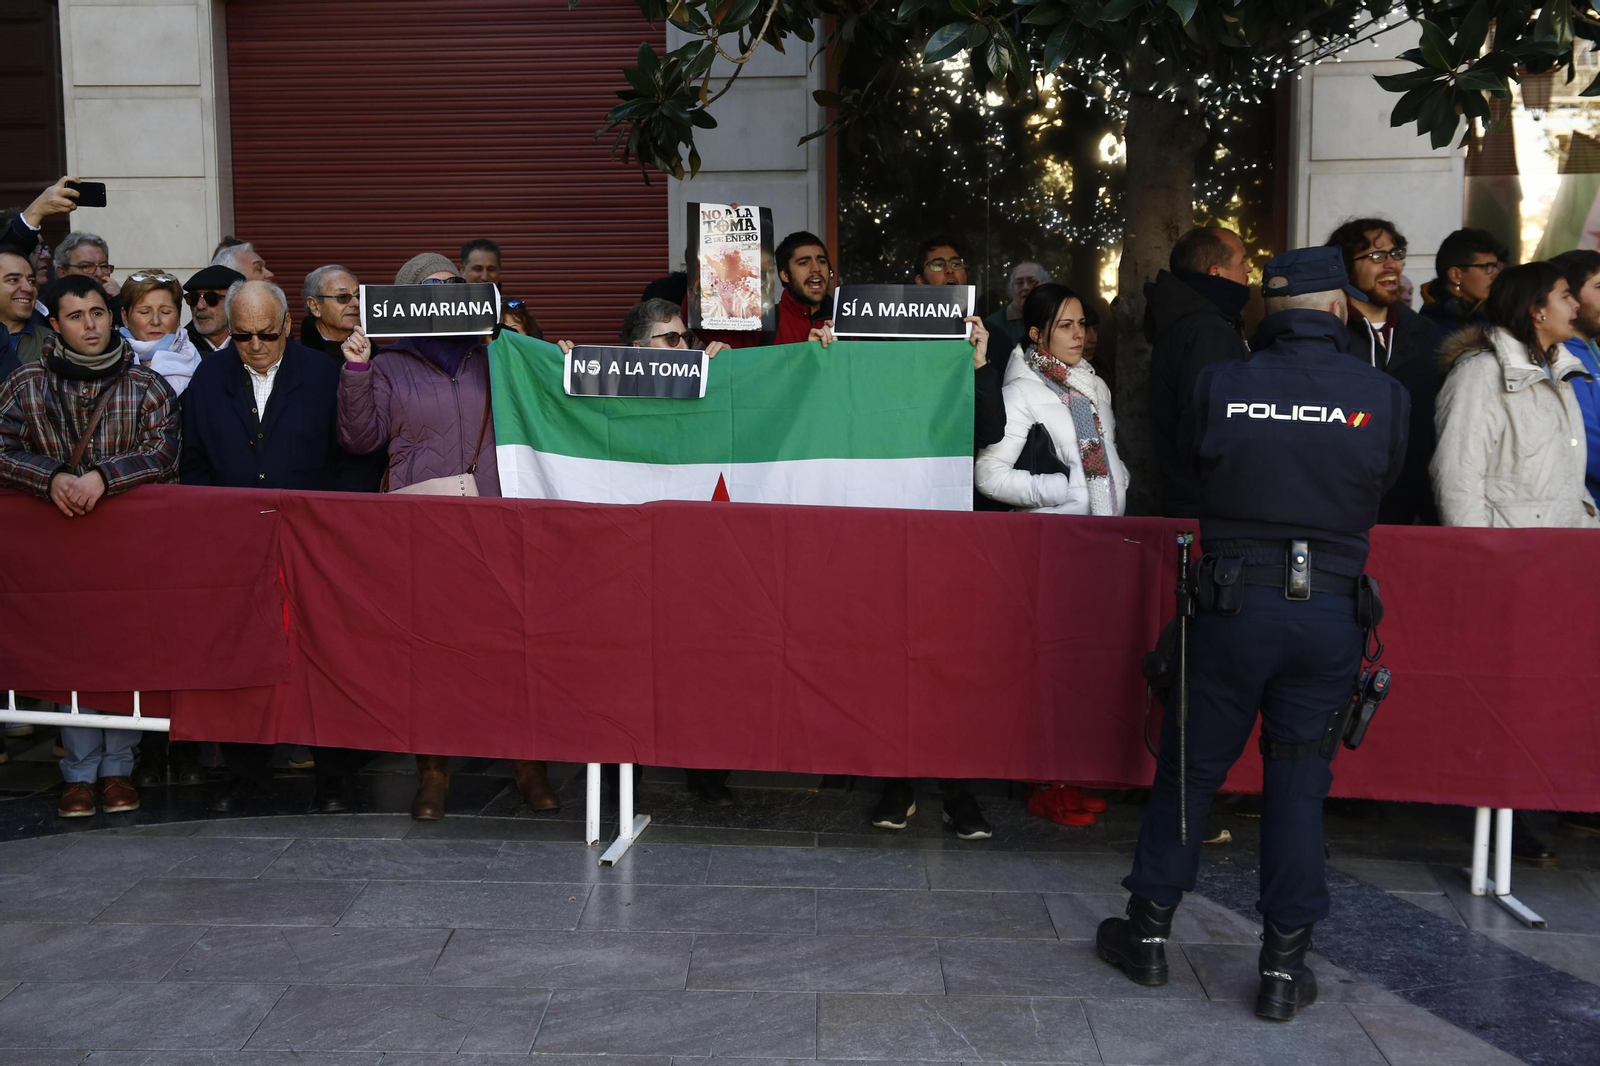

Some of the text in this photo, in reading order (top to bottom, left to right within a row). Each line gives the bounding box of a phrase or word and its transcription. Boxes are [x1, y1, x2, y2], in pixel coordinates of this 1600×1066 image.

[701, 208, 753, 220] NO A LA
[703, 218, 756, 233] TOMA
[705, 236, 712, 244] 2
[725, 234, 758, 242] ENERO
[372, 299, 494, 318] SÍ A MARIANA
[841, 298, 963, 318] SÍ A MARIANA
[573, 359, 701, 378] NO A LA TOMA
[1226, 403, 1347, 424] POLICIA
